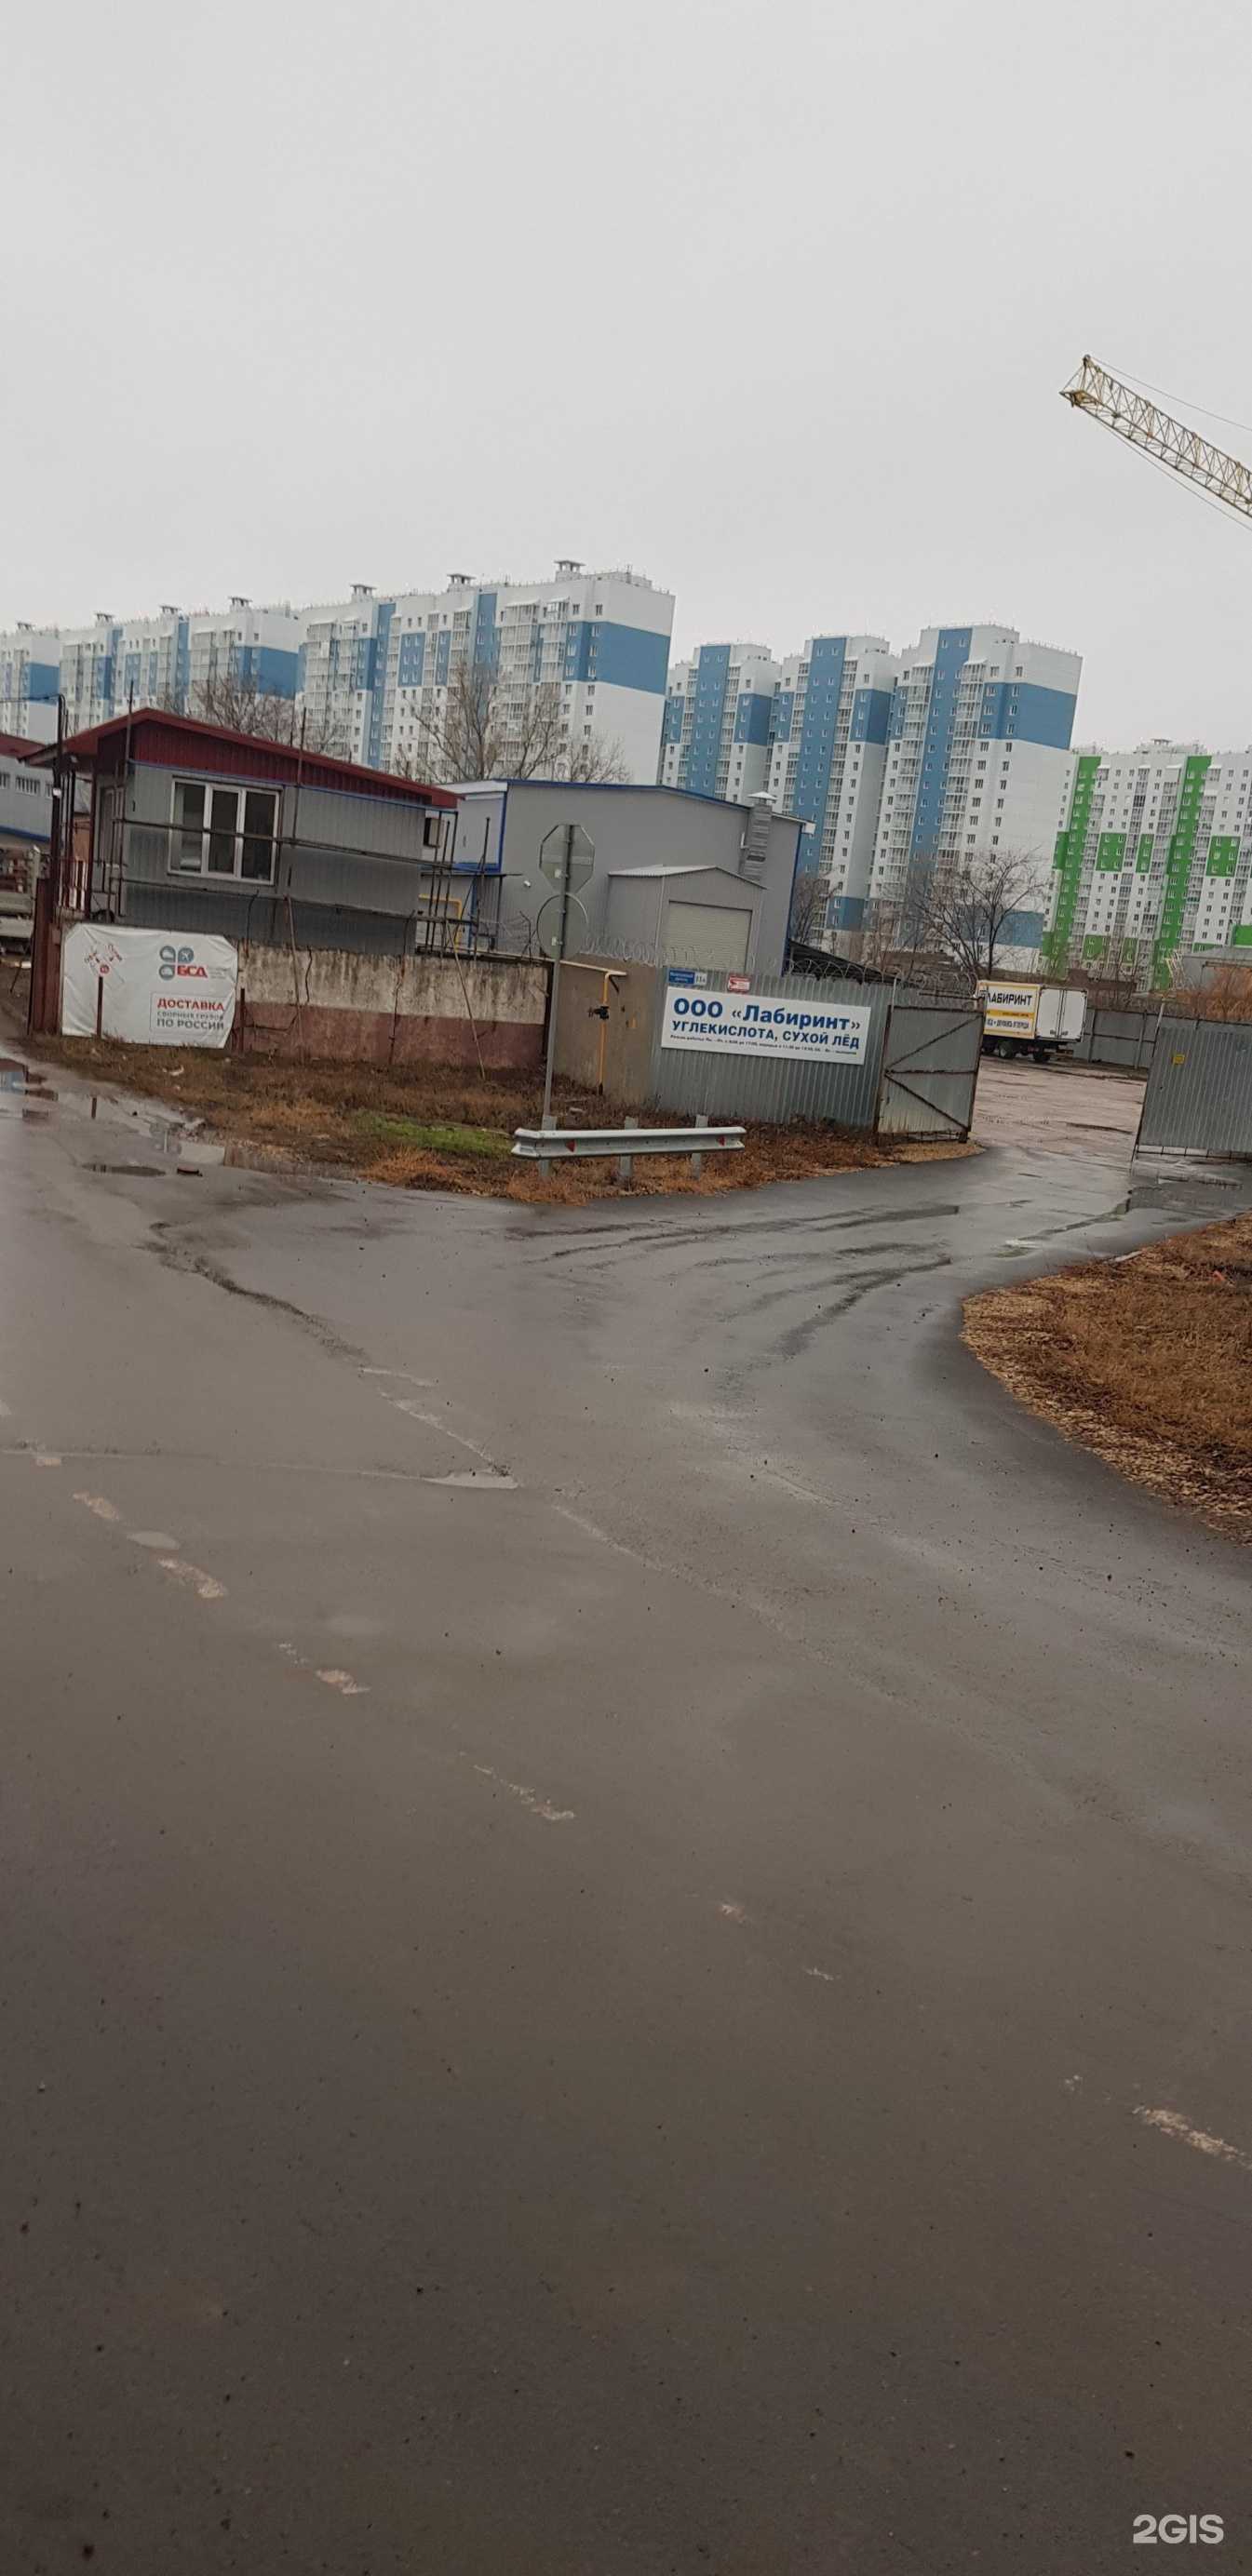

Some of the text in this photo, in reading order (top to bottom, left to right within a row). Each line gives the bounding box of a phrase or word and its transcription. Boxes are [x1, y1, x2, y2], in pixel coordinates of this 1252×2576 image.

[157, 998, 224, 1011] ДОСТАВКА
[673, 998, 861, 1030] ООО «Лабиринт»
[156, 1018, 224, 1030] ПО РОССИИ
[672, 1020, 778, 1041] УГЛЕКИСЛОТА,
[782, 1030, 828, 1045] СУХОЙ
[832, 1034, 860, 1050] ЛЁД
